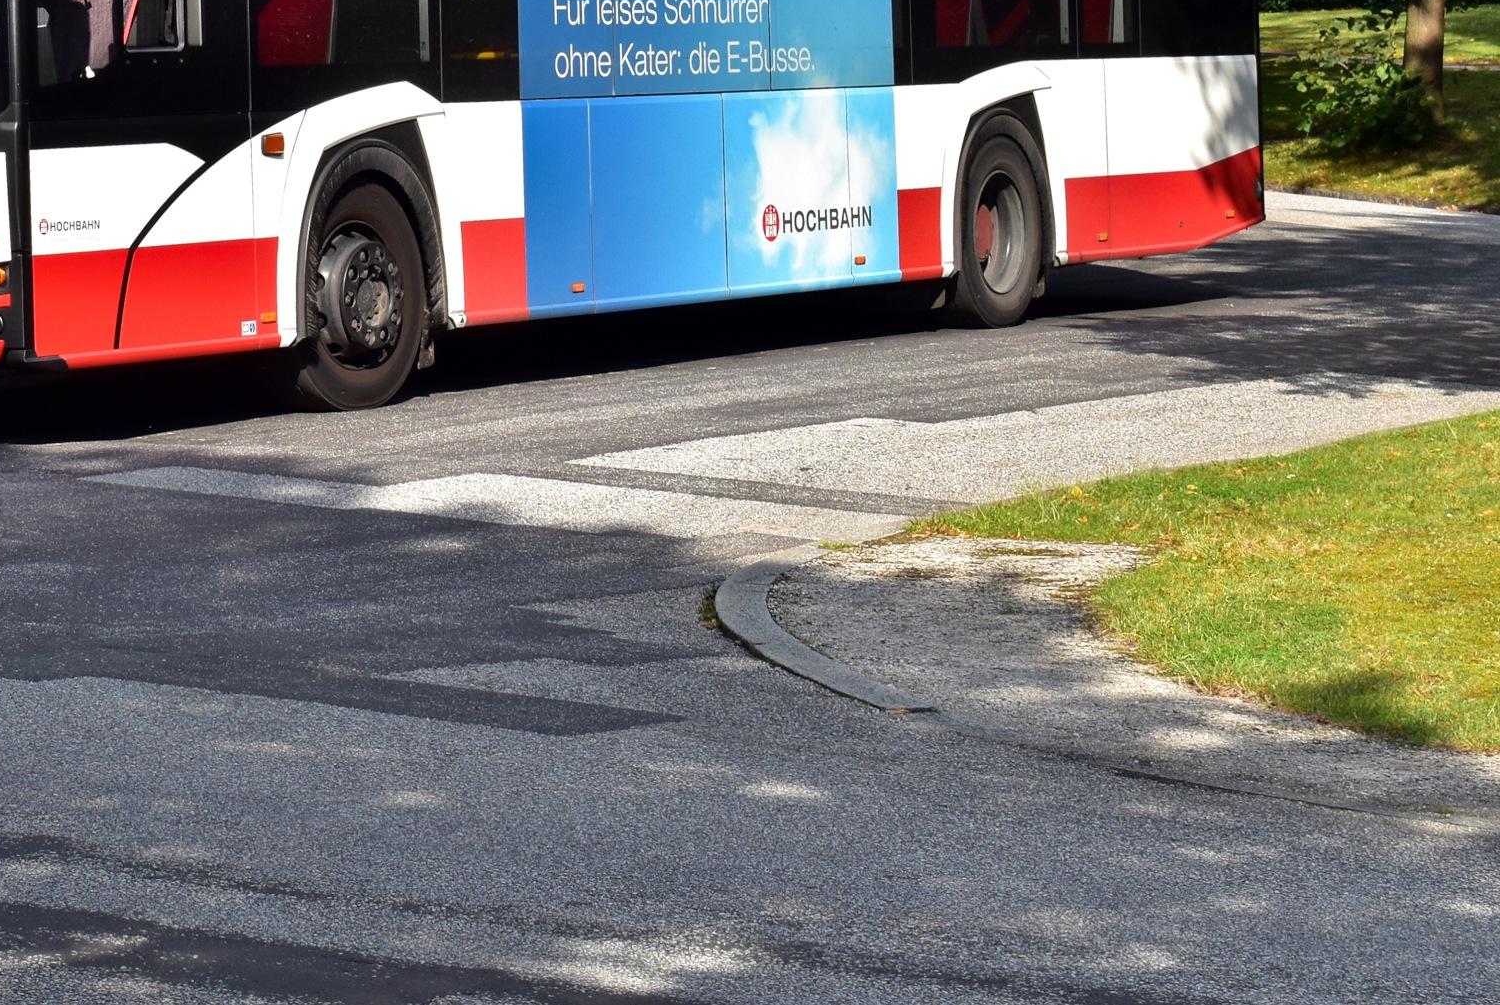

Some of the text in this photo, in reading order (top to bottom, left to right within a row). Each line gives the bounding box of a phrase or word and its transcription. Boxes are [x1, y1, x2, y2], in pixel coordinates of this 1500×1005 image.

[554, 39, 815, 78] ohne Kater: die E-Busse.
[50, 219, 100, 232] HOCHBAHN
[782, 205, 873, 234] HOCHBAHN
